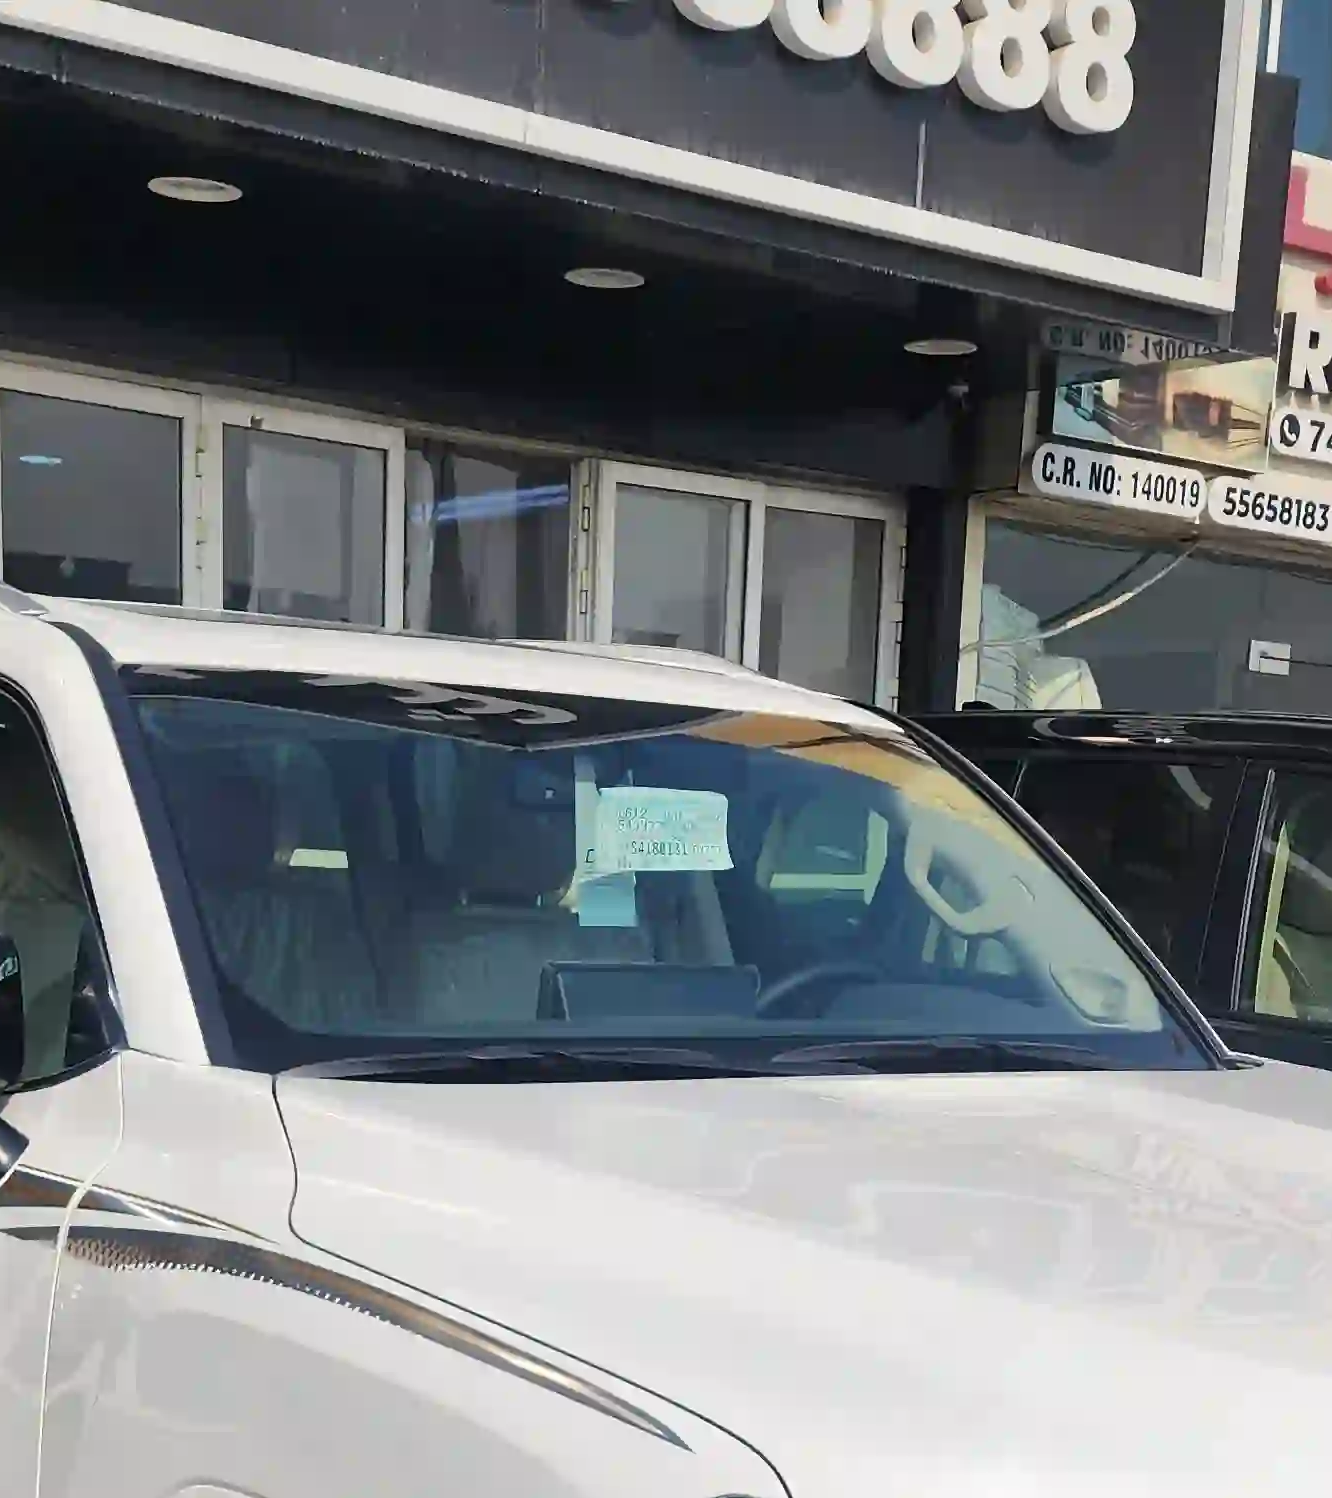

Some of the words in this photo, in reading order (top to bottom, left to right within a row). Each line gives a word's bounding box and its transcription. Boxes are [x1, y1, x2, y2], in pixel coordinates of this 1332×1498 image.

[1041, 451, 1081, 488] C.R.
[1088, 461, 1122, 496] NO:
[1131, 471, 1200, 508] 140019
[1222, 486, 1330, 532] 55658183
